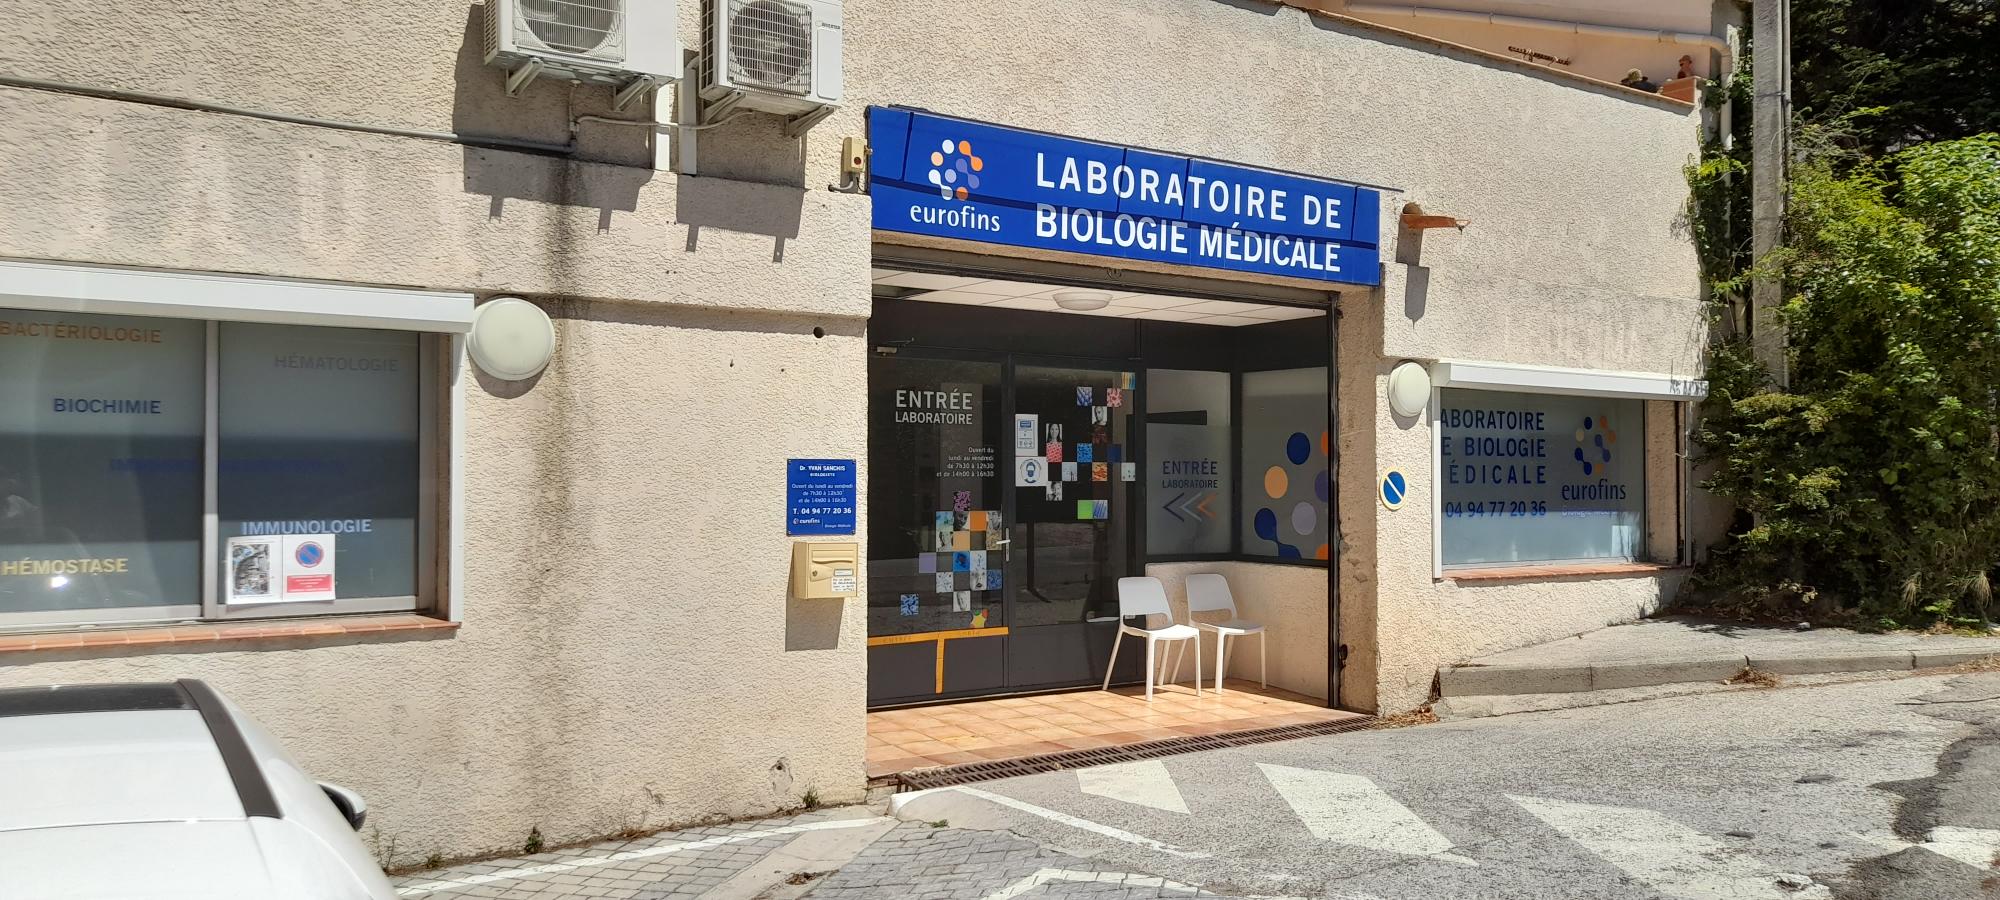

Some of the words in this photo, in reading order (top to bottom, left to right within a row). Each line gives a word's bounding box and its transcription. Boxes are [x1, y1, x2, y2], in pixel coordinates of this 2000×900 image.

[1037, 152, 1287, 222] LABORATOIRE
[1303, 194, 1341, 229] DE
[910, 205, 1000, 232] eurofins
[1036, 202, 1188, 254] BIOLOGIE
[1200, 222, 1341, 272] MÉDICALE
[0, 321, 161, 343] BACTÉRIOLOGIE
[274, 352, 398, 372] HÉMATOLOGIE
[53, 398, 161, 414] BIOCHIMIE
[896, 388, 972, 410] ENTRÉE
[895, 411, 973, 425] LABORATOIRE
[1441, 409, 1544, 430] ABORATOIRE
[1441, 437, 1452, 456] E
[1465, 437, 1546, 458] BIOLOGIE
[1162, 458, 1218, 475] ENTRÉE
[1449, 459, 1546, 484] ÉDICALE
[1162, 480, 1218, 488] LABORATOIRE
[1562, 478, 1626, 500] eurofins
[1446, 502, 1462, 518] 04
[1468, 502, 1484, 518] 94
[1489, 502, 1505, 518] 77
[1510, 501, 1526, 517] 20
[1530, 500, 1546, 516] 36
[240, 519, 372, 535] IMMUNOLOGIE
[1, 557, 128, 576] HÉMOSTASE
